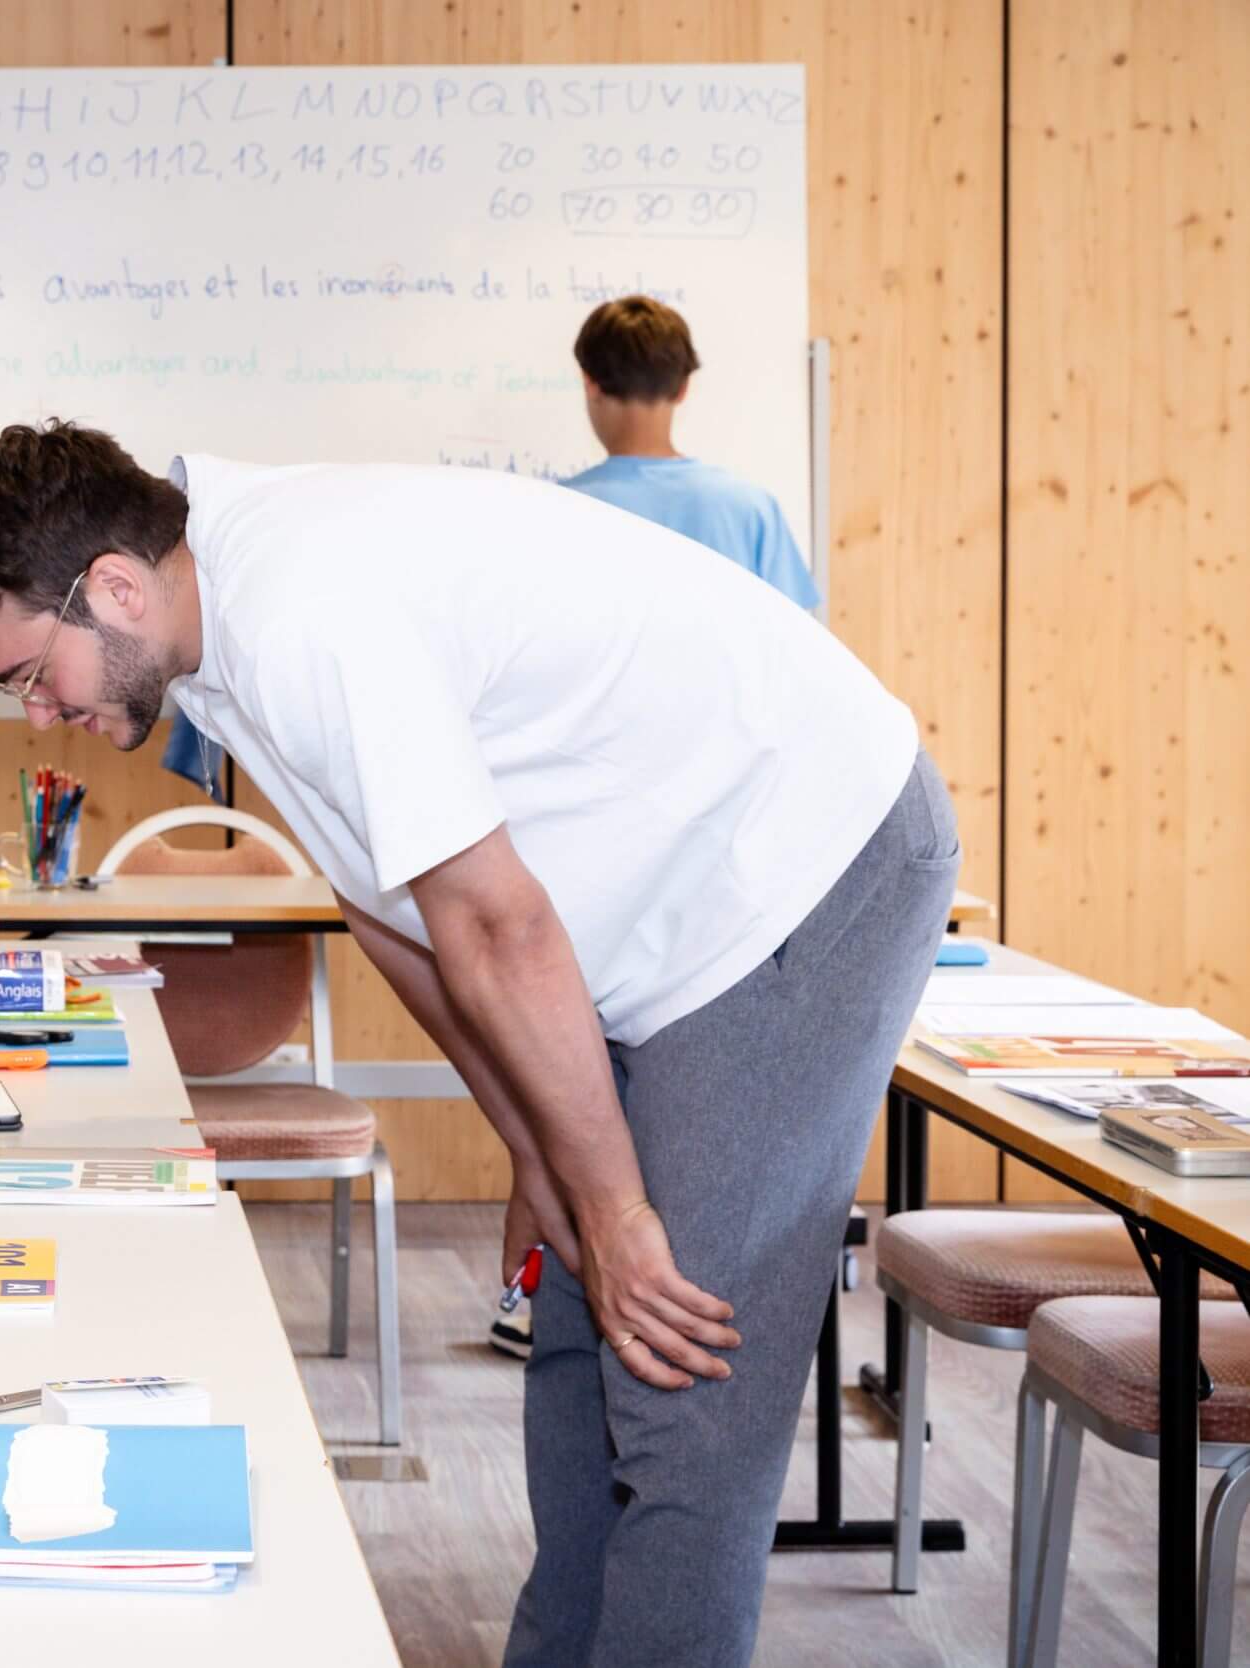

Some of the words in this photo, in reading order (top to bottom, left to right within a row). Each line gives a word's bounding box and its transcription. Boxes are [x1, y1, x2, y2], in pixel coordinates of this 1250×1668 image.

[13, 87, 52, 132] H
[108, 79, 152, 126] J
[176, 79, 212, 123] K
[230, 82, 276, 122] L
[293, 82, 334, 118] M
[355, 82, 388, 117] N
[393, 83, 421, 117] O
[435, 80, 458, 118] P
[468, 80, 512, 116] Q
[526, 78, 552, 119] R
[561, 80, 590, 116] S
[626, 80, 652, 113] U
[660, 83, 684, 108] V
[23, 152, 49, 190] 9
[410, 145, 445, 174] 16
[498, 142, 534, 172] 20
[581, 143, 622, 174] 30
[635, 143, 680, 172] 40
[706, 143, 762, 173] 50
[489, 187, 531, 218] 60
[568, 192, 617, 225] 70
[634, 192, 674, 225] 80
[689, 191, 741, 226] 90
[43, 258, 189, 320] avantages
[203, 264, 238, 299] et
[261, 265, 299, 298] les
[472, 270, 505, 299] de
[527, 267, 550, 301] la
[202, 342, 262, 376] and
